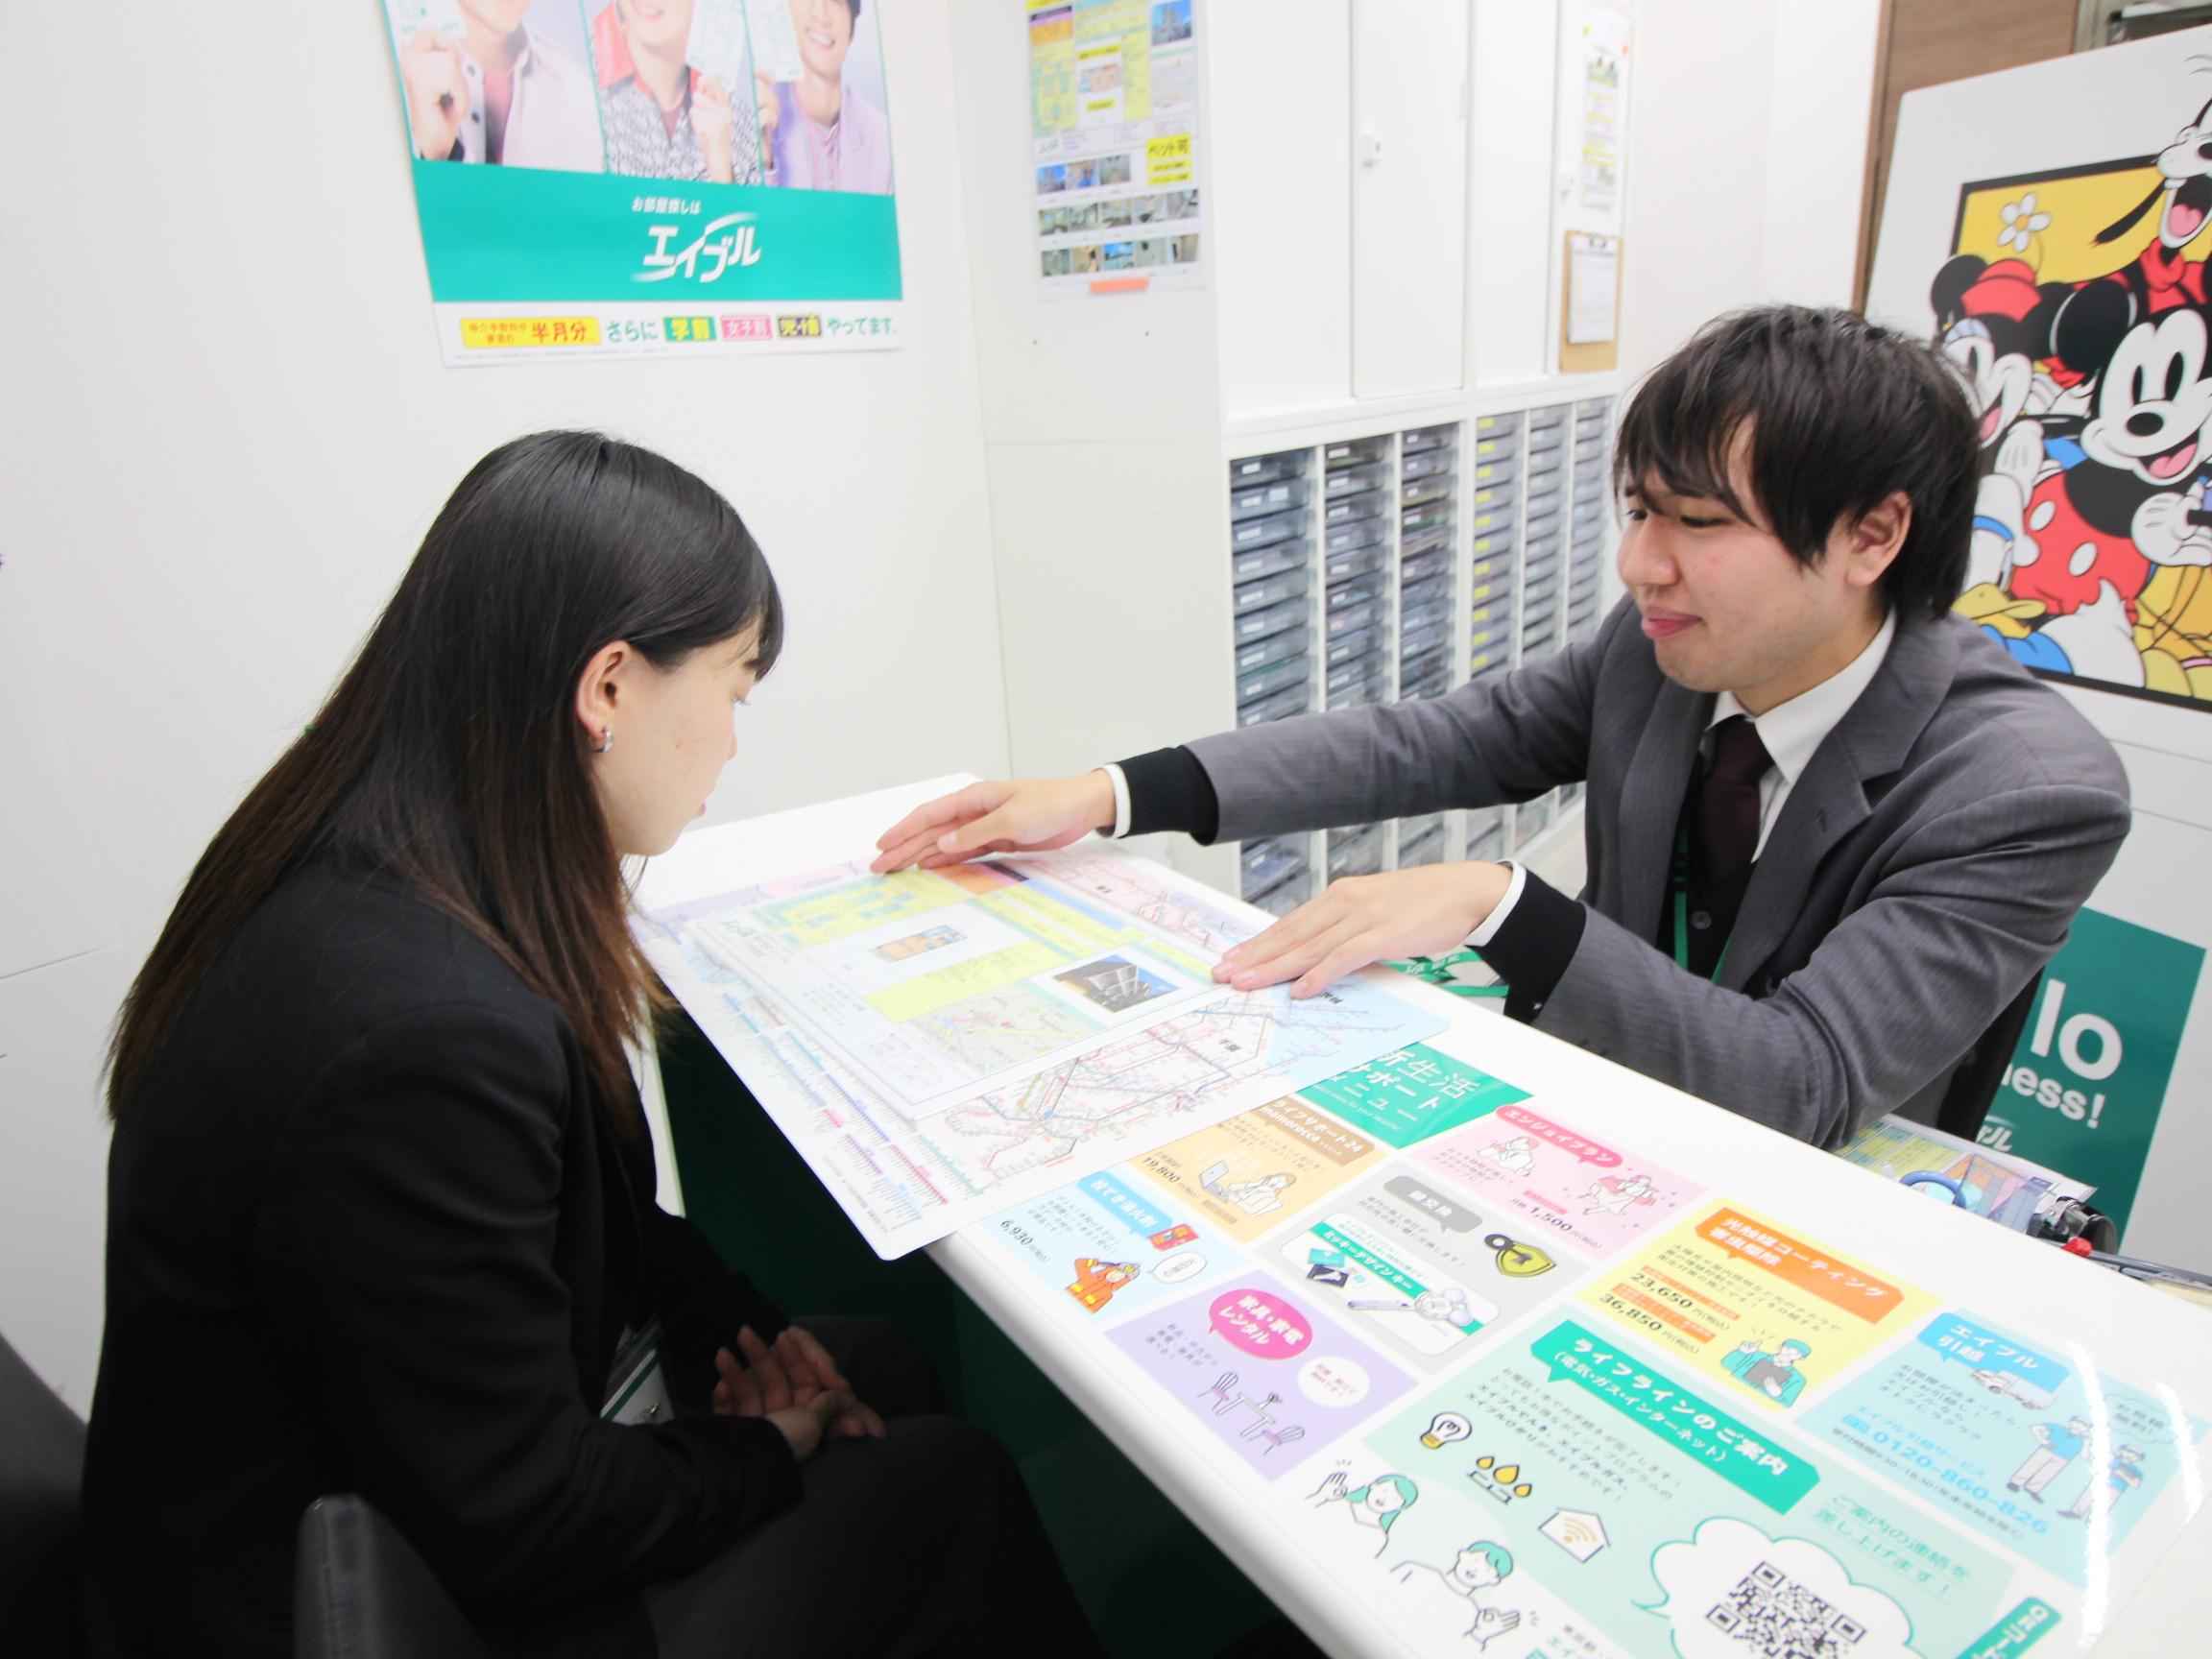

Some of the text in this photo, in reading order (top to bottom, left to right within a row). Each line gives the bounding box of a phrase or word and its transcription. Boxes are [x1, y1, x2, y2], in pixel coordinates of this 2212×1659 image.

[632, 196, 702, 215] お部屋探しは
[636, 214, 761, 283] エイブル
[606, 320, 659, 343] さらに
[1503, 1110, 1617, 1163] エンジョイプラン
[1139, 1157, 1182, 1183] 19,800
[997, 1219, 1035, 1245] 6,930
[1527, 1207, 1574, 1232] 1,500
[1628, 1273, 1695, 1309] 23,650
[1216, 1307, 1273, 1345] レンタル
[1597, 1293, 1665, 1332] 36,850
[1935, 1334, 1986, 1363] 引越
[1950, 1324, 2042, 1371] エイブル
[1566, 1337, 1791, 1477] ライフラインのご案内
[1870, 1428, 2052, 1539] 0120-860-826
